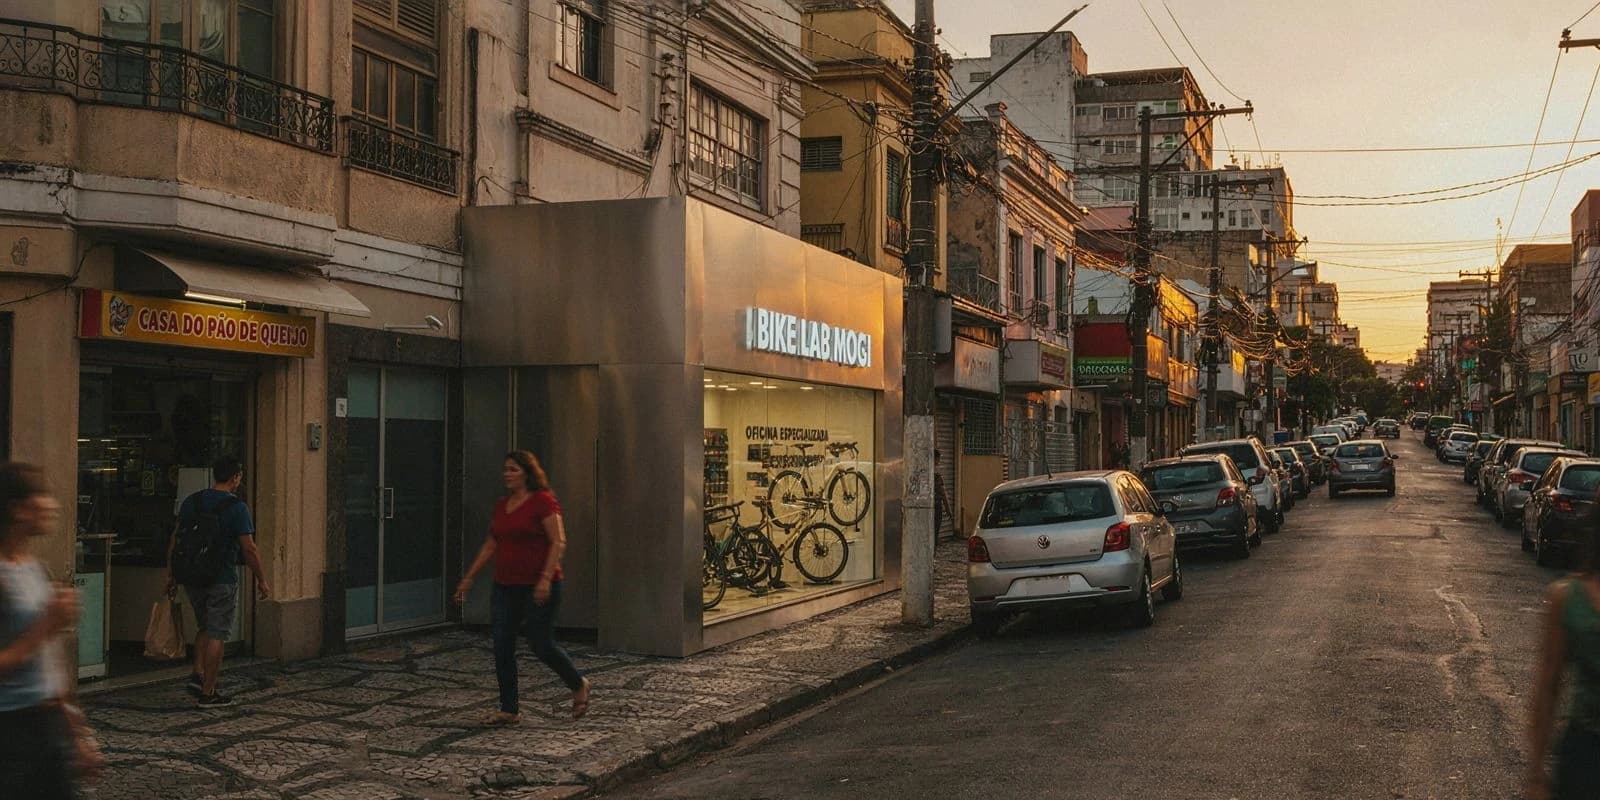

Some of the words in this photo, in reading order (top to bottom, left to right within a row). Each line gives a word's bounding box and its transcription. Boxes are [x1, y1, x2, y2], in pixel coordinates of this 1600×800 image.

[138, 307, 179, 333] CASA
[182, 312, 204, 337] DO
[207, 312, 236, 341] PÃO
[259, 322, 309, 348] QUEIJO
[757, 307, 798, 355] BIKE
[801, 318, 831, 361] LAB
[834, 326, 872, 368] MOGI
[745, 425, 778, 440] OFICINA
